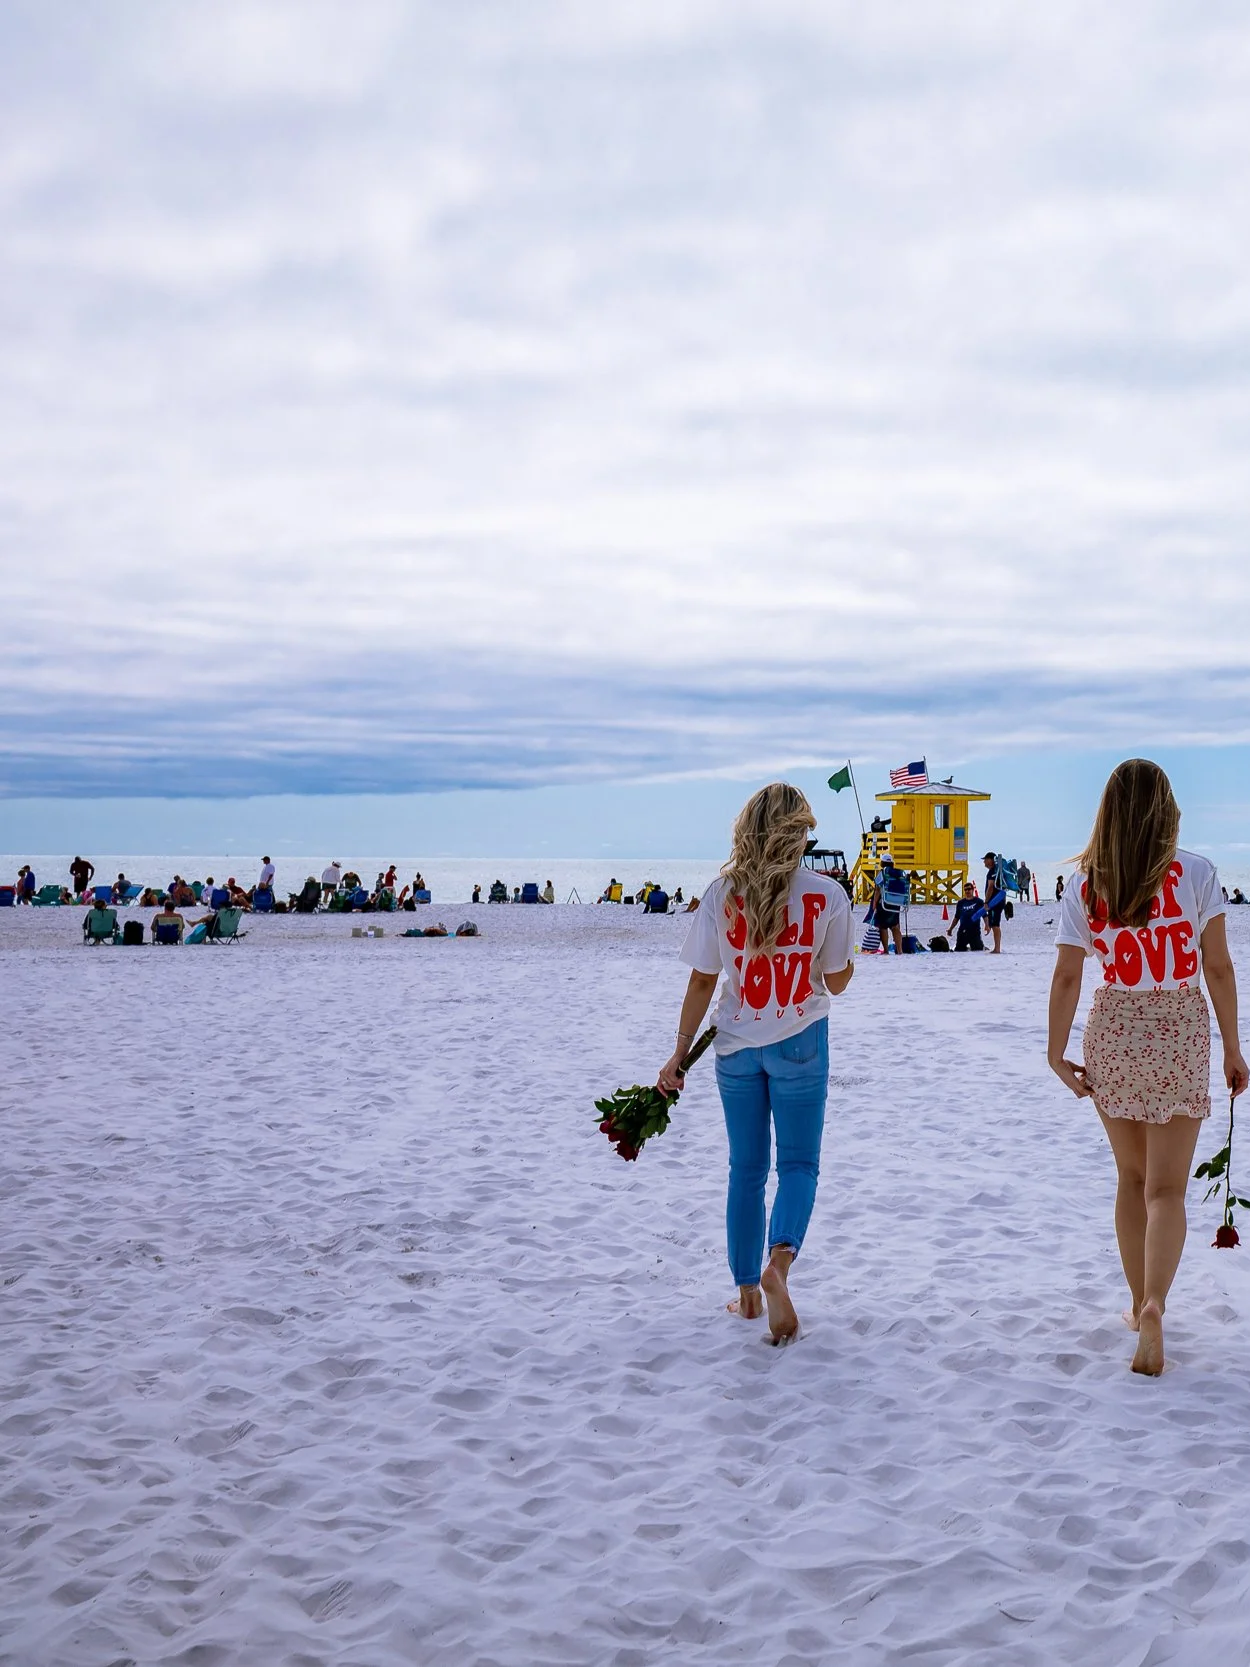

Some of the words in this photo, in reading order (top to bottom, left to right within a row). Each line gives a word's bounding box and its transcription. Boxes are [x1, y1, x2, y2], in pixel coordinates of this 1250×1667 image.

[724, 893, 827, 951] SLF
[1081, 860, 1184, 934] SF
[1092, 920, 1199, 988] LOVE
